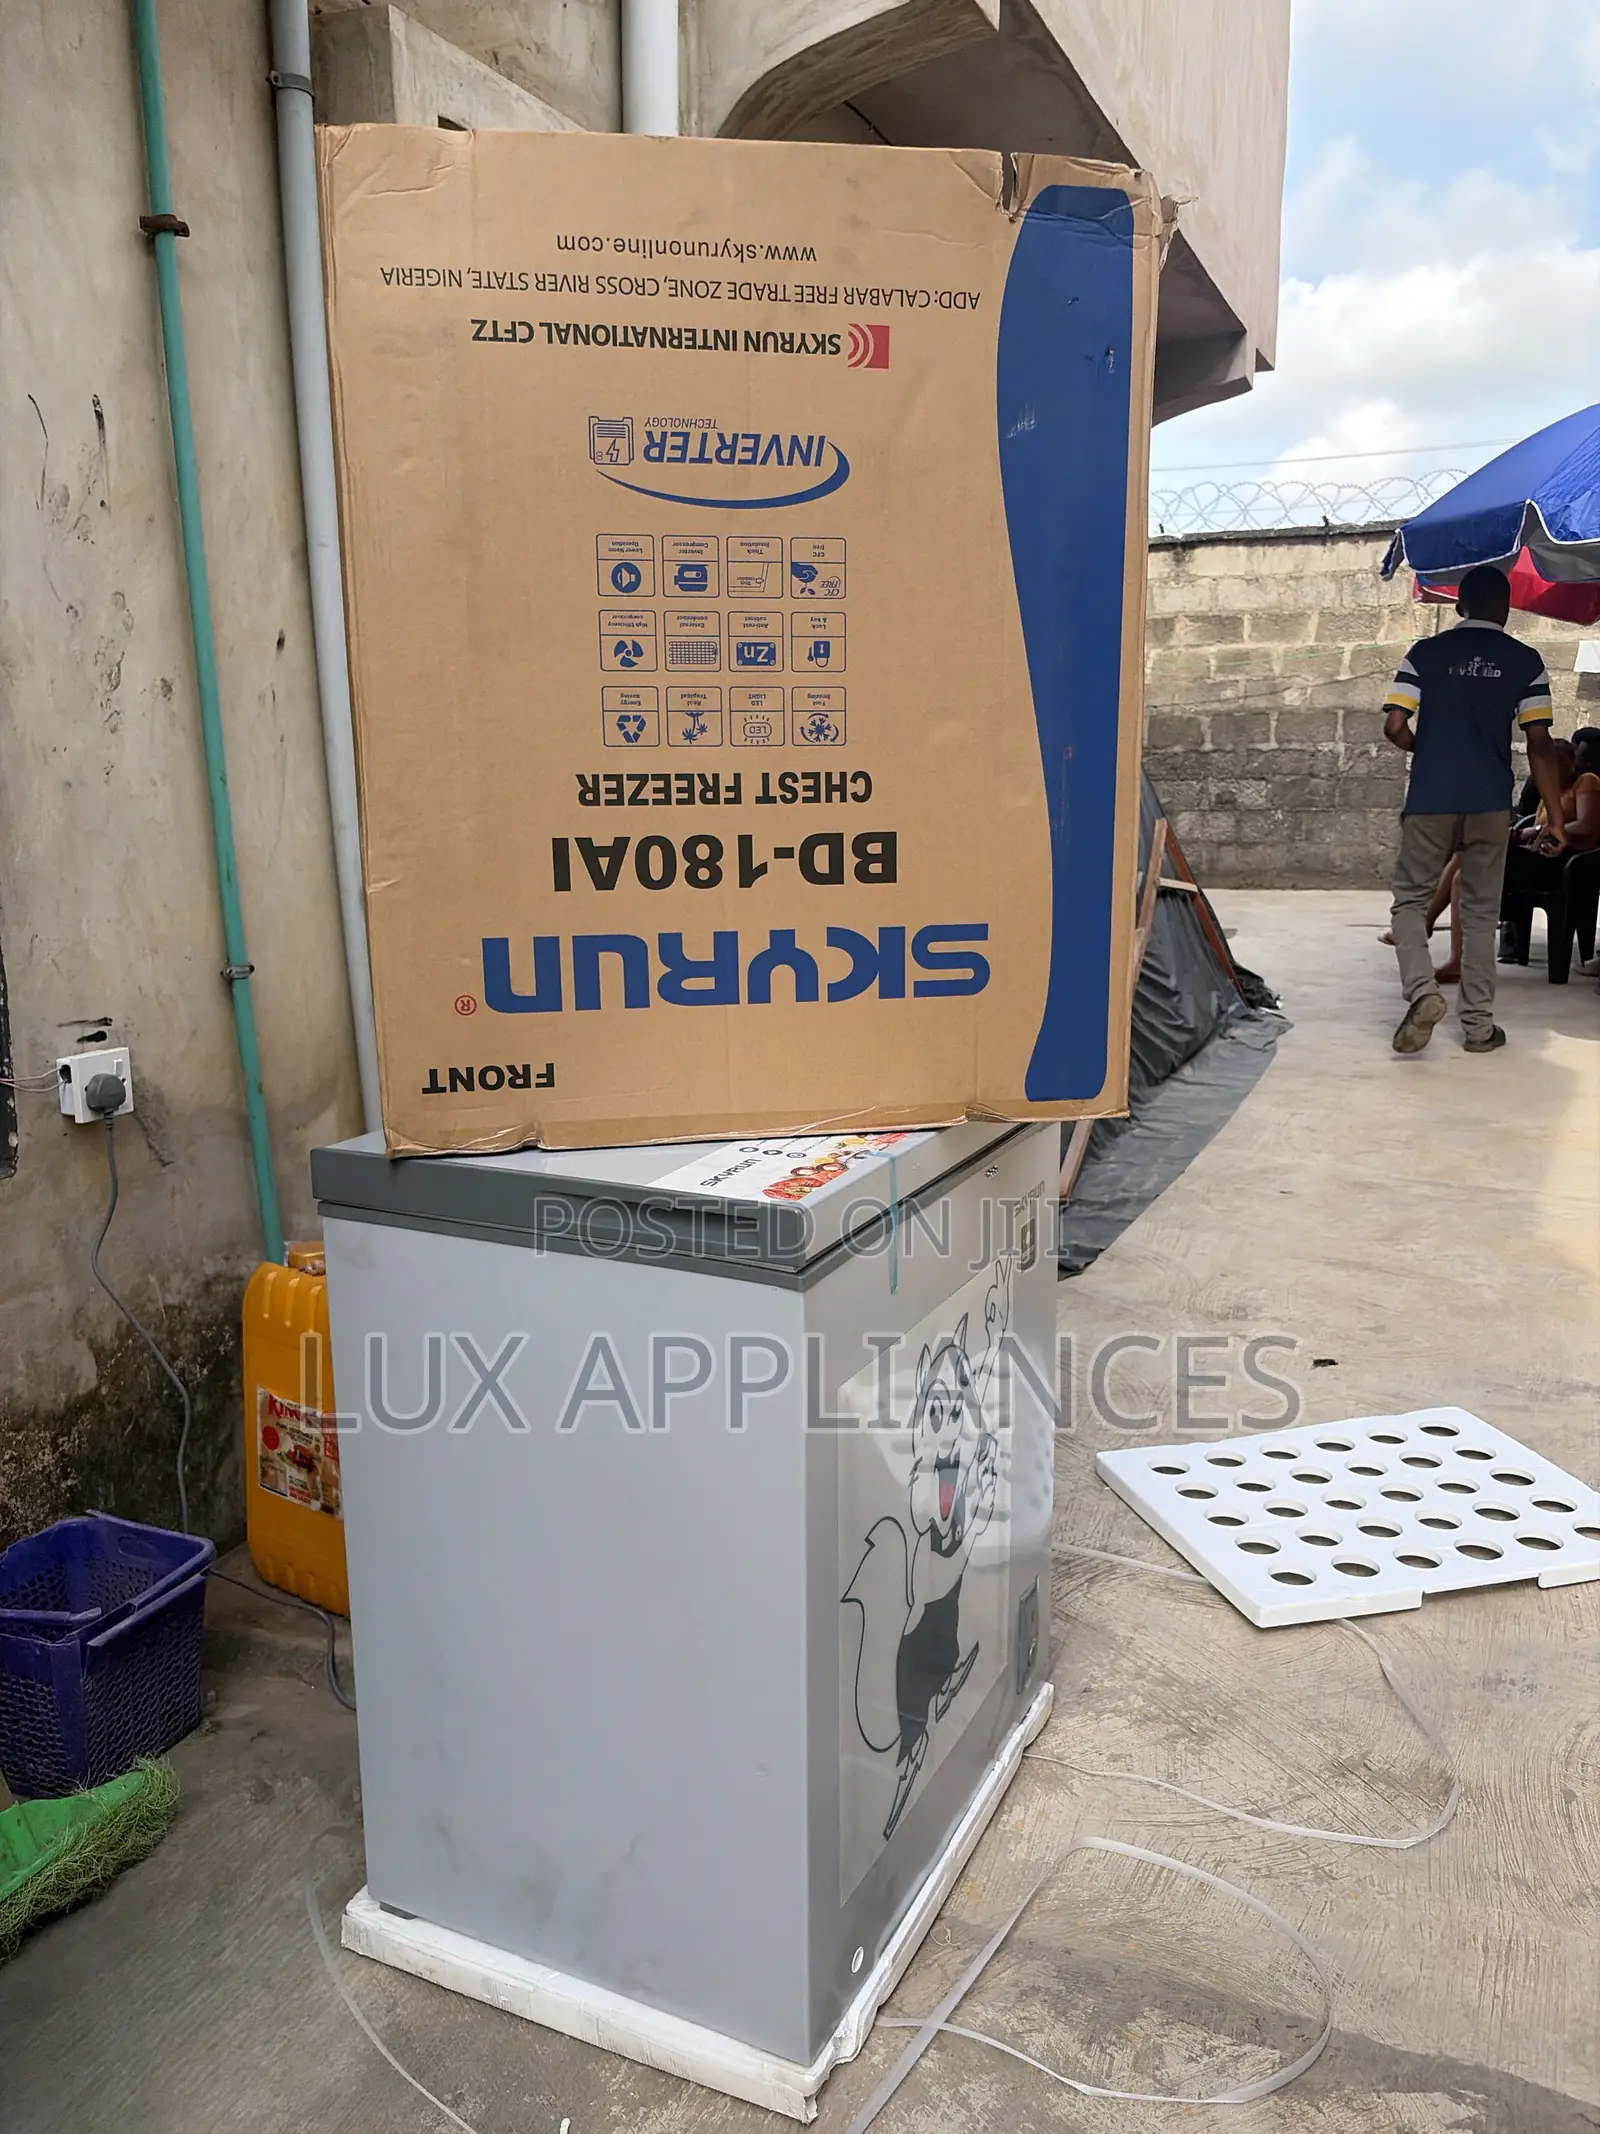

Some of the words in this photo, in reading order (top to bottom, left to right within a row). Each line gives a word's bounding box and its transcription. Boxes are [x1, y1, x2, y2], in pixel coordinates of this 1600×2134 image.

[556, 233, 817, 266] www.skyrunonline.com
[379, 266, 463, 289] NIGERIA
[465, 267, 529, 292] STATE,
[533, 272, 590, 294] RIVER
[595, 276, 660, 297] CROSS
[664, 276, 722, 301] ZONE,
[726, 281, 792, 303] TRADE
[793, 284, 839, 305] FREE
[843, 286, 931, 308] CALABAR
[470, 319, 534, 345] CFTZ
[539, 321, 739, 352] INTERNATIONAL
[744, 330, 842, 355] SKYRUN
[644, 417, 718, 429] TECHNOLOGY
[643, 430, 826, 467] INVERTER
[744, 646, 769, 662] Zn
[574, 773, 742, 808] FREEZER
[755, 770, 873, 805] CHEST
[551, 831, 898, 893] BD-180AI
[480, 923, 991, 1015] SKYRUN
[420, 1063, 556, 1095] FRONT
[700, 1158, 762, 1187] SKYRUN
